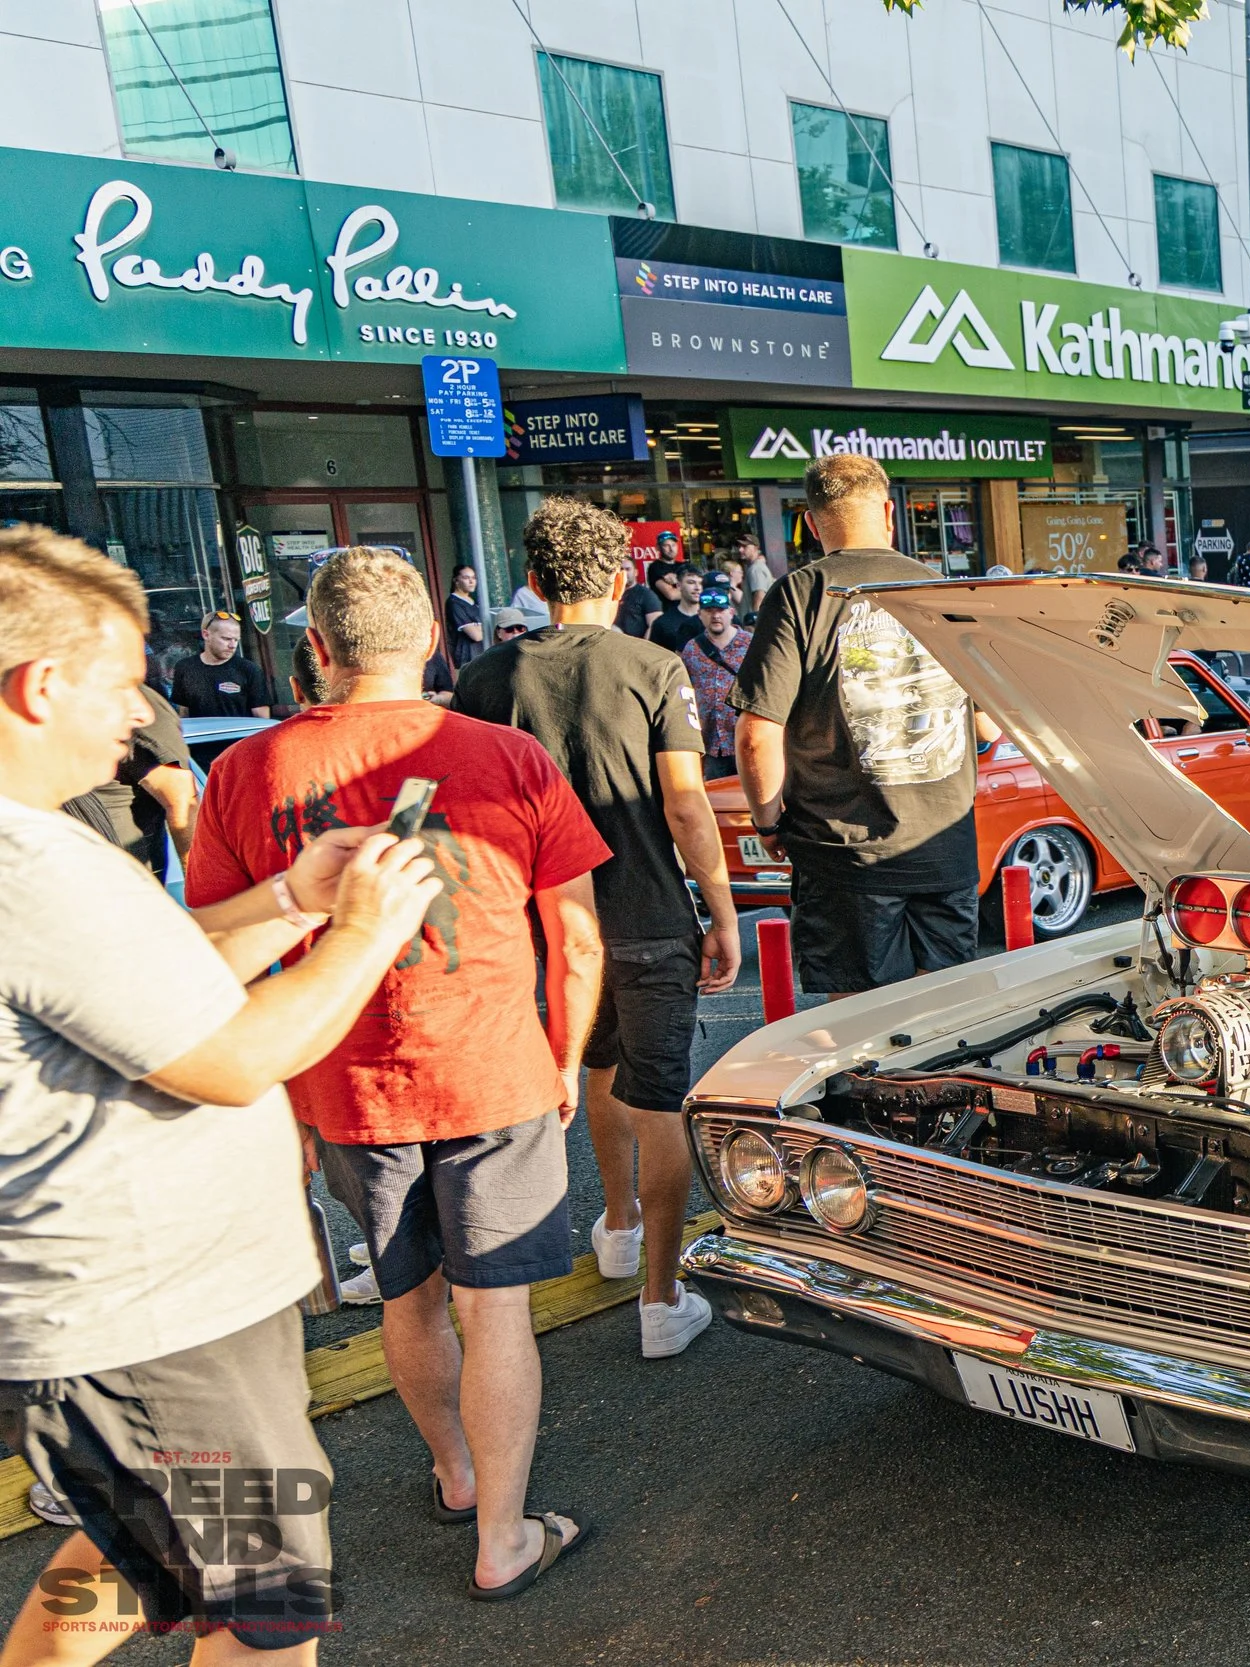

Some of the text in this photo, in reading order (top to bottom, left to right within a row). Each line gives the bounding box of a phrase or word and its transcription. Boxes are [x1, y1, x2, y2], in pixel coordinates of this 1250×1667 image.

[74, 179, 517, 344] Paddy Pallin
[663, 274, 834, 305] STEP INTO HEALTH CARE
[360, 324, 498, 349] SINCE 1930
[652, 332, 828, 360] BROWNSTONE
[440, 359, 480, 384] 2P
[527, 412, 599, 431] STEP INTO
[529, 429, 627, 449] HEALTH CARE
[326, 460, 337, 475] 6
[239, 535, 264, 574] BIG
[1048, 532, 1095, 562] 50%
[1197, 538, 1232, 550] PARKING
[252, 600, 271, 623] SALE
[988, 1374, 1102, 1439] LUSHH
